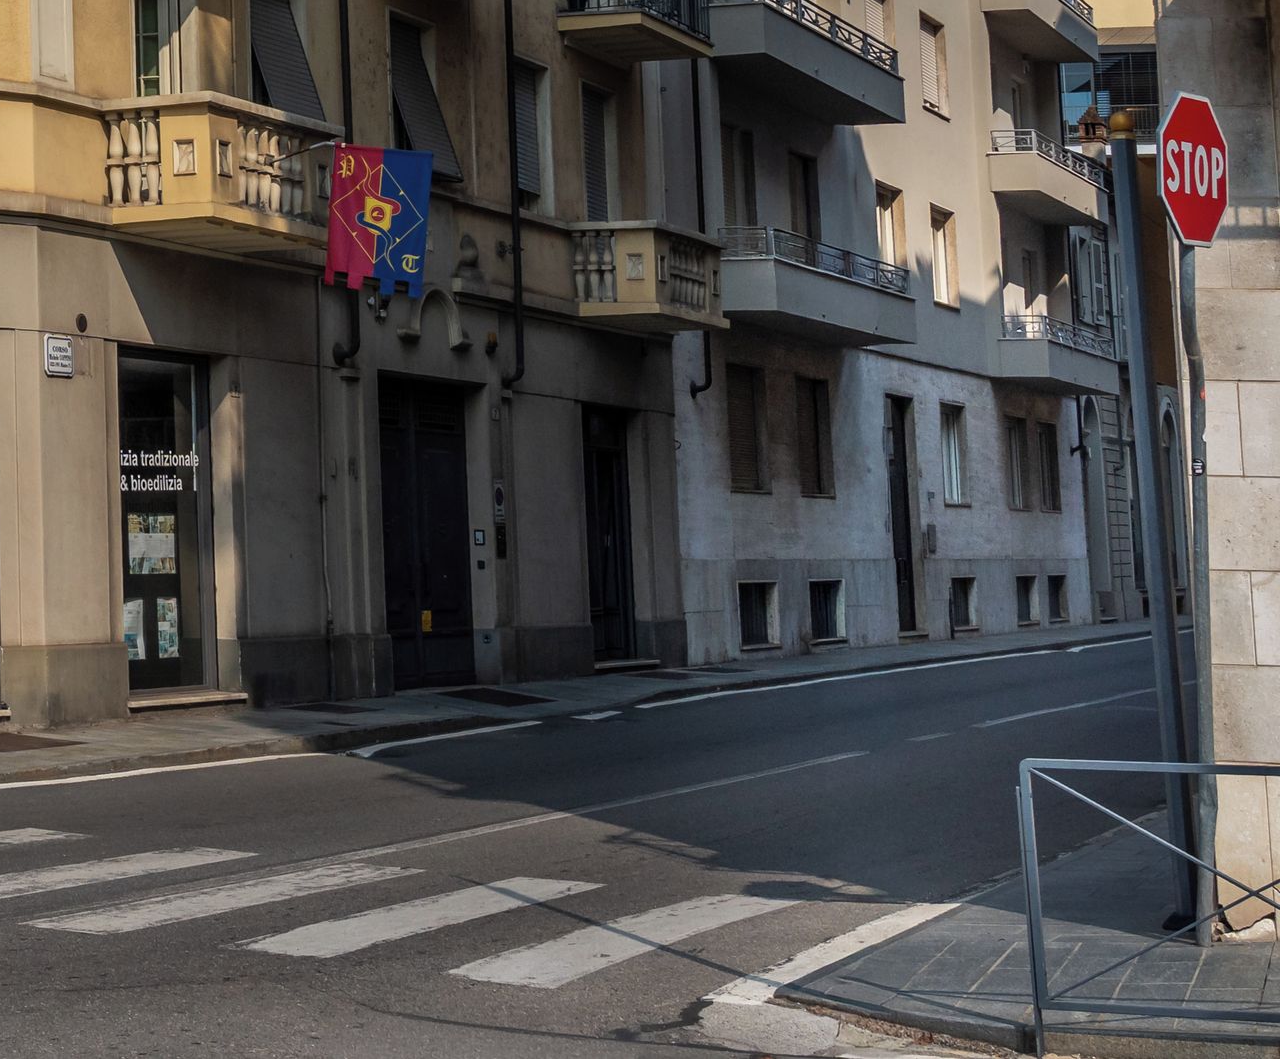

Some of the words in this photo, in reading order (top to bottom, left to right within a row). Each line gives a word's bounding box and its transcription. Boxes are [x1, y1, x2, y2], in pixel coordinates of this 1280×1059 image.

[1166, 139, 1224, 199] STOP
[140, 450, 199, 467] tradizionale
[120, 475, 129, 491] &
[131, 474, 183, 491] bioedilizia
